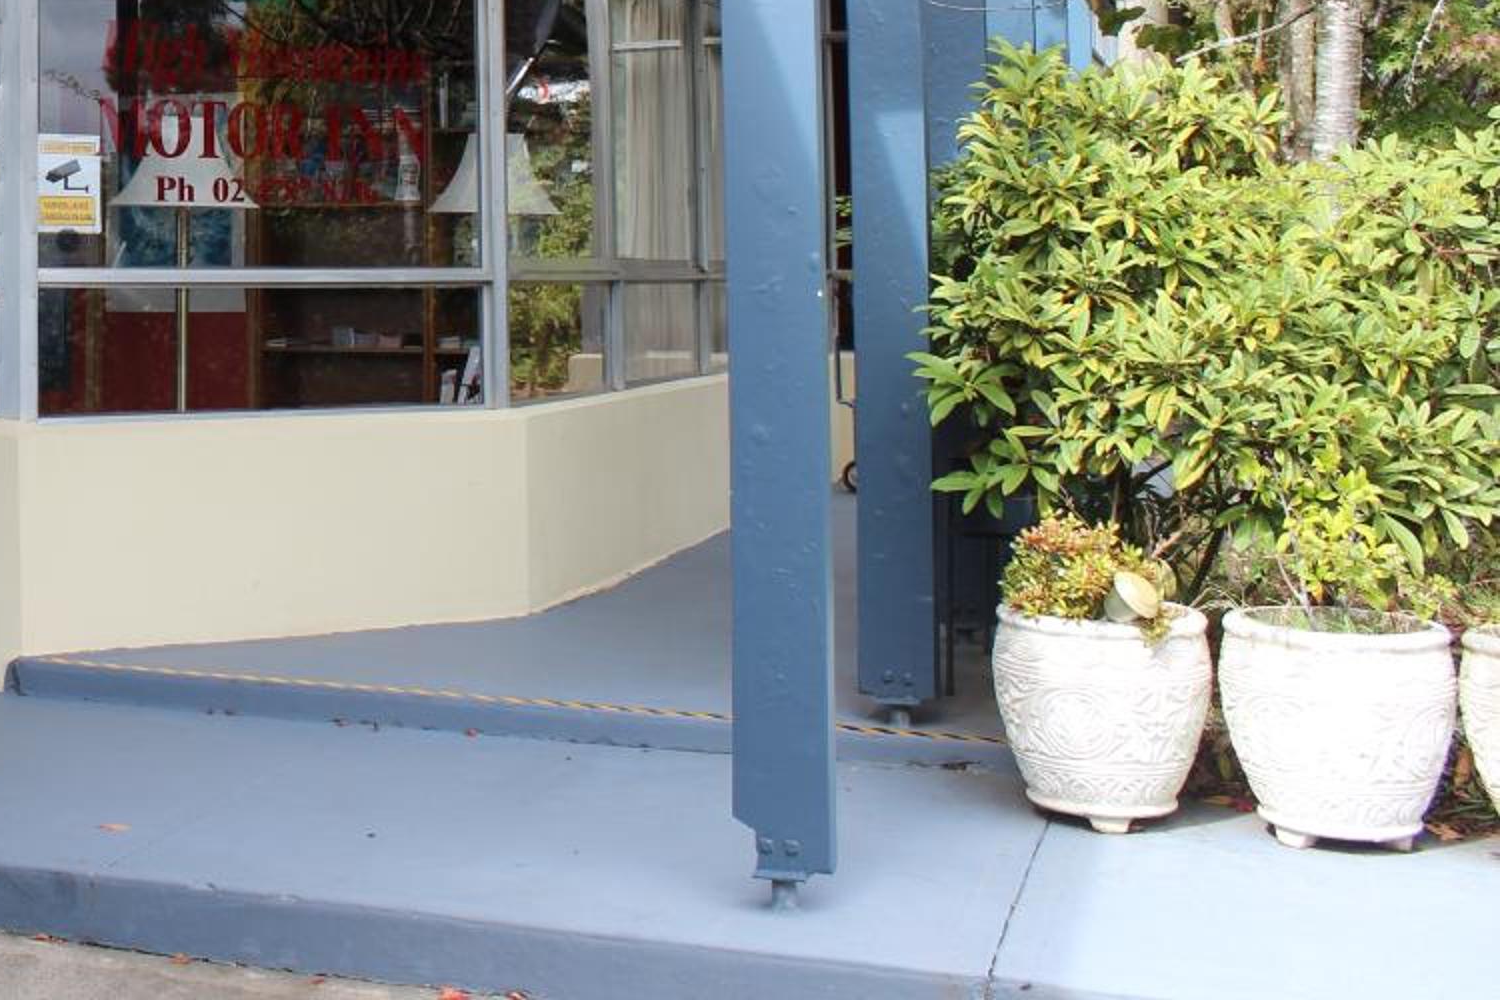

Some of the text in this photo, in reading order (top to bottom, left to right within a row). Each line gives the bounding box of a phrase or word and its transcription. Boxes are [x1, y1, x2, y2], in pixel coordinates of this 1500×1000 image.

[98, 97, 426, 165] MOTOR INN
[156, 176, 195, 202] Ph
[213, 176, 245, 203] 02
